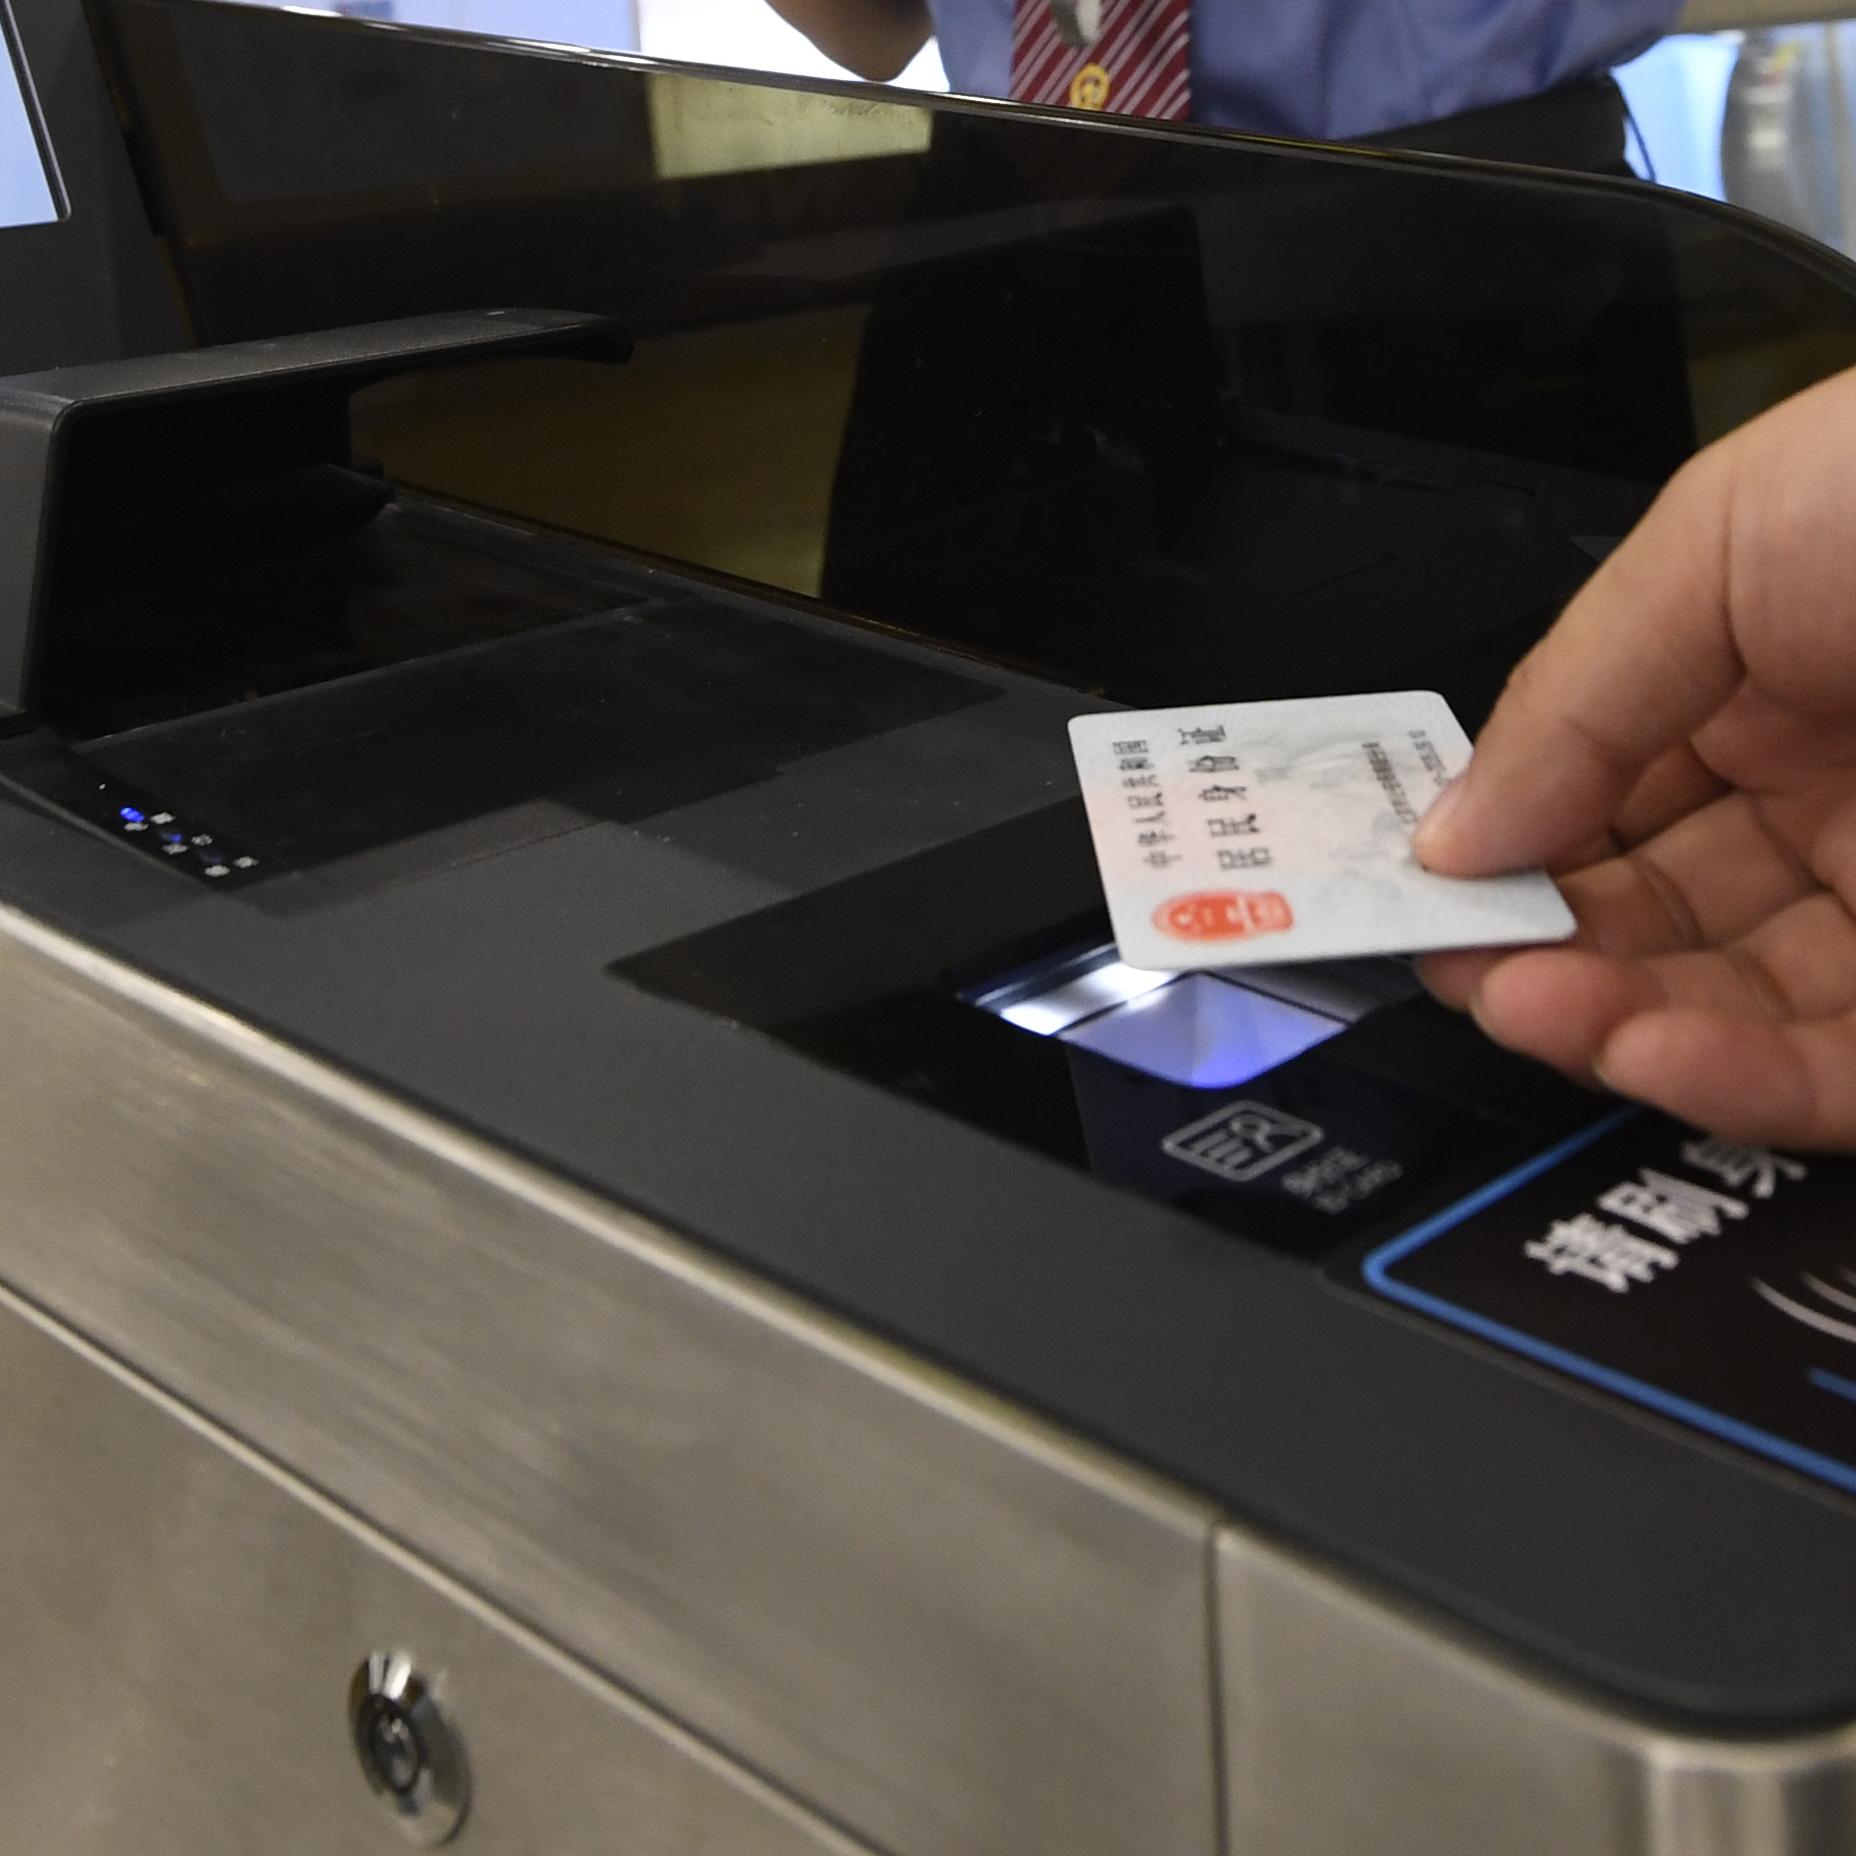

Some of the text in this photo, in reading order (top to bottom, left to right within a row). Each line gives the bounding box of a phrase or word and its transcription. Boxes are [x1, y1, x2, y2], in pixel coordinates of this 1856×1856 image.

[1112, 739, 1182, 869] 中华人民共和国
[1177, 725, 1274, 871] 居民身份证
